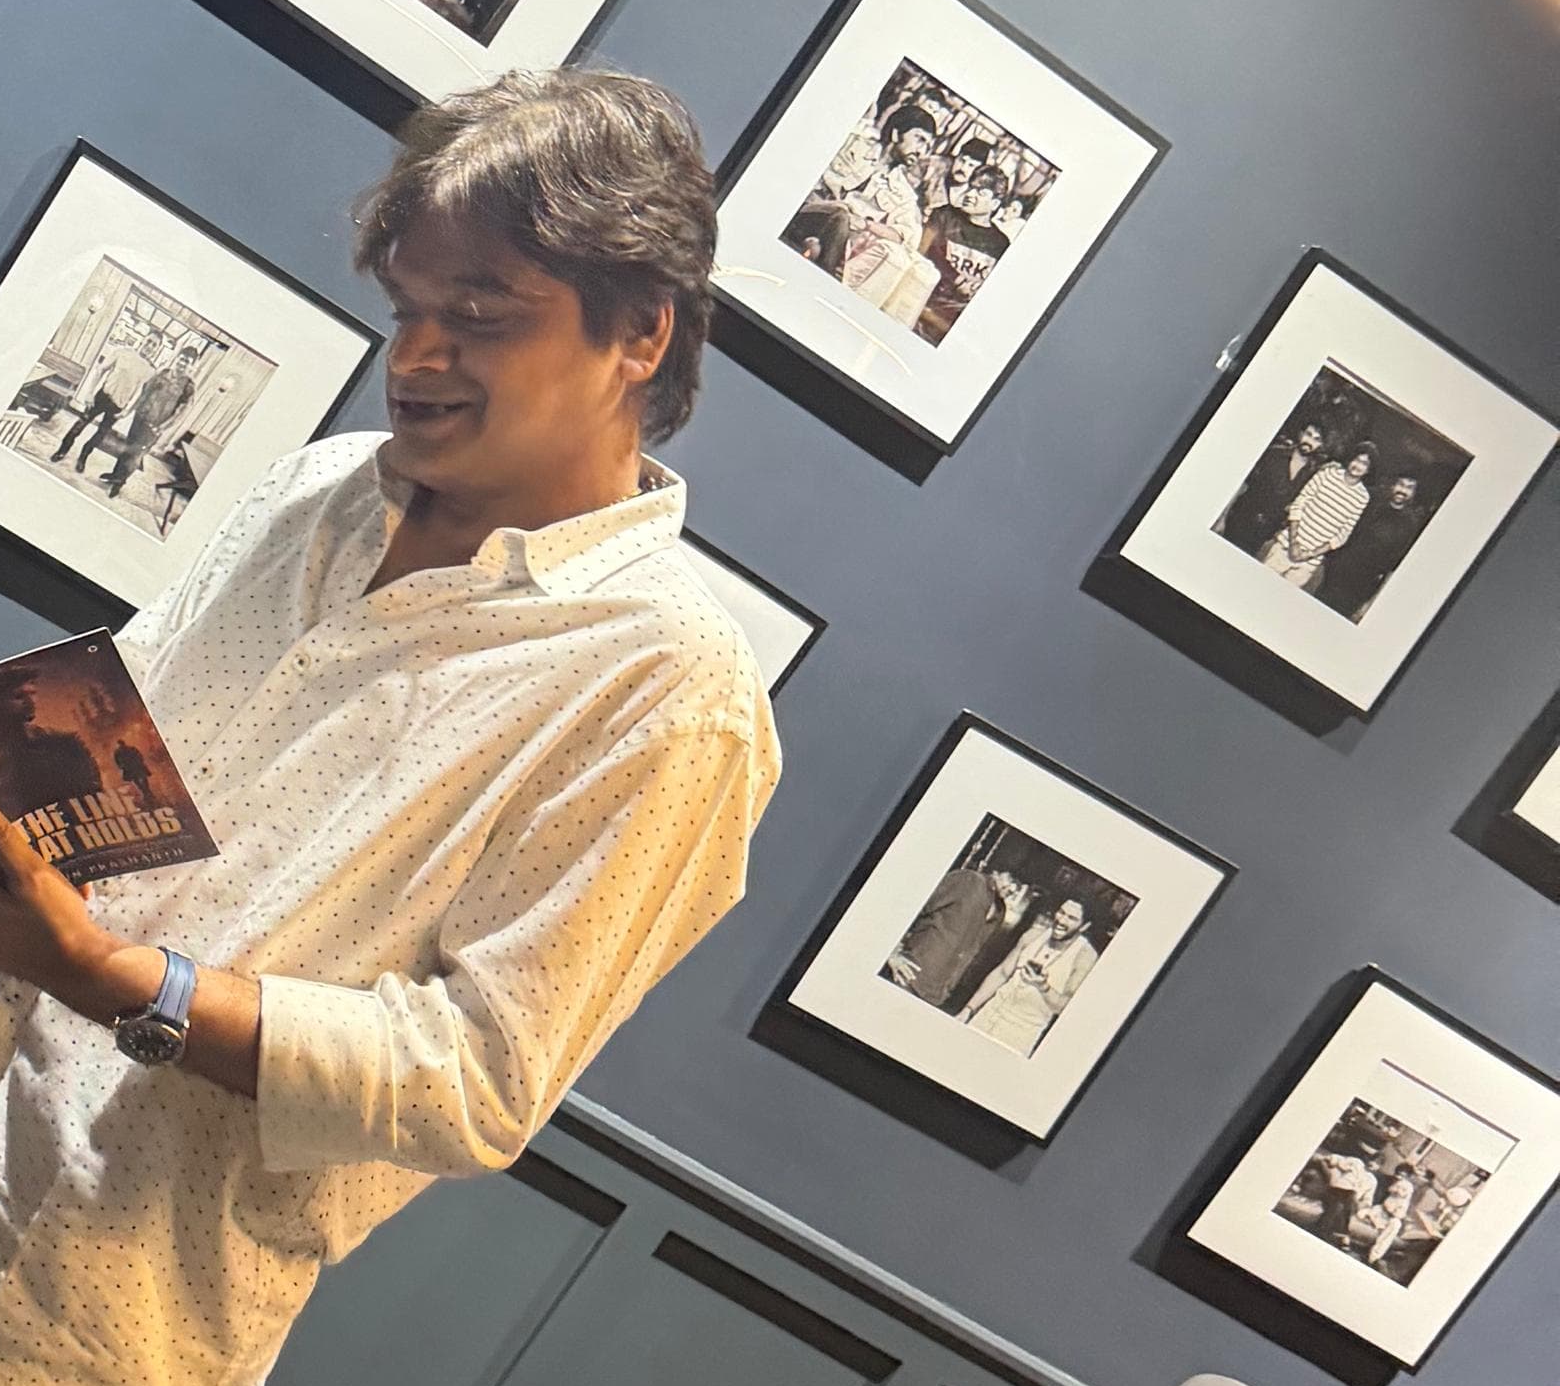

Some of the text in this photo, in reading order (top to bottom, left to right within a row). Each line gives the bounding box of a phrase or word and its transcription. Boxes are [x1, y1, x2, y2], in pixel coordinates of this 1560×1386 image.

[11, 785, 141, 843] THE LINE
[38, 806, 182, 863] AT HOLDS
